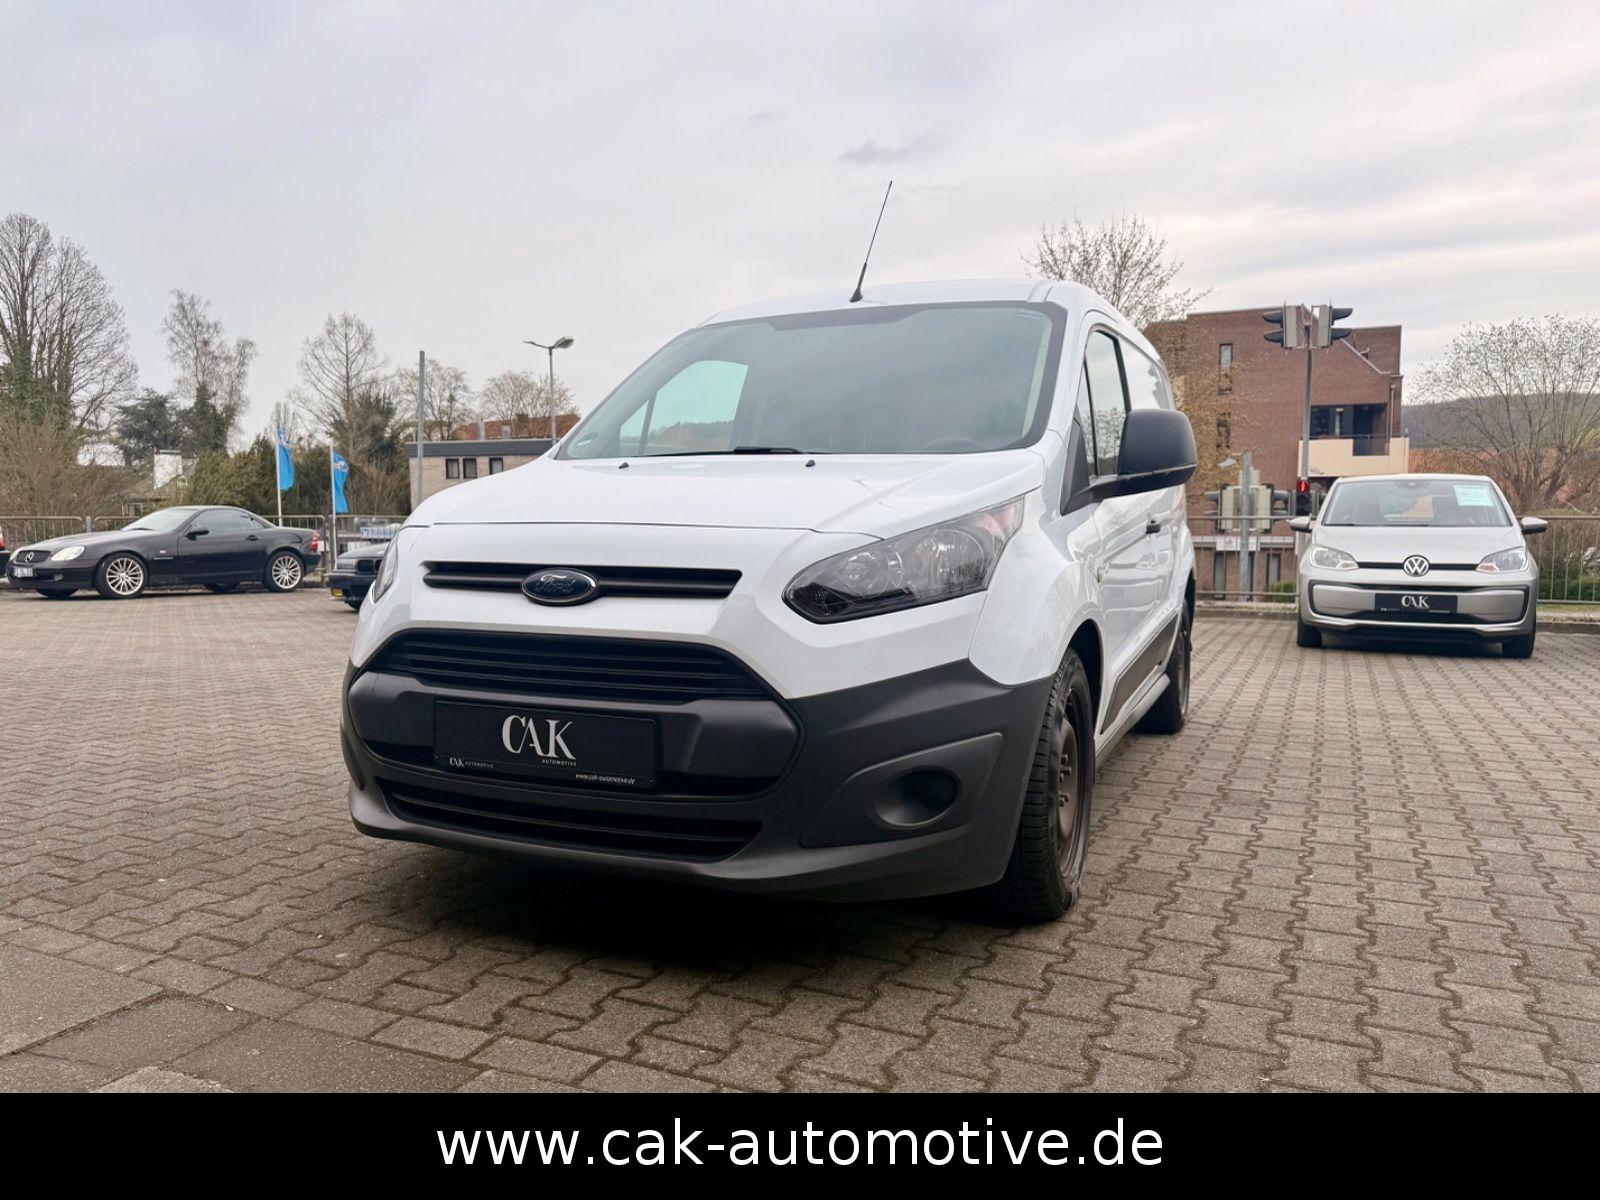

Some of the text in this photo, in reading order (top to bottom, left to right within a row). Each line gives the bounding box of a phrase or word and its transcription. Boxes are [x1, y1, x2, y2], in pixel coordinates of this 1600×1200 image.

[1401, 595, 1430, 608] CAK
[501, 715, 577, 760] CAK
[449, 756, 465, 768] CAK
[541, 758, 577, 768] AUTOMOTIVE
